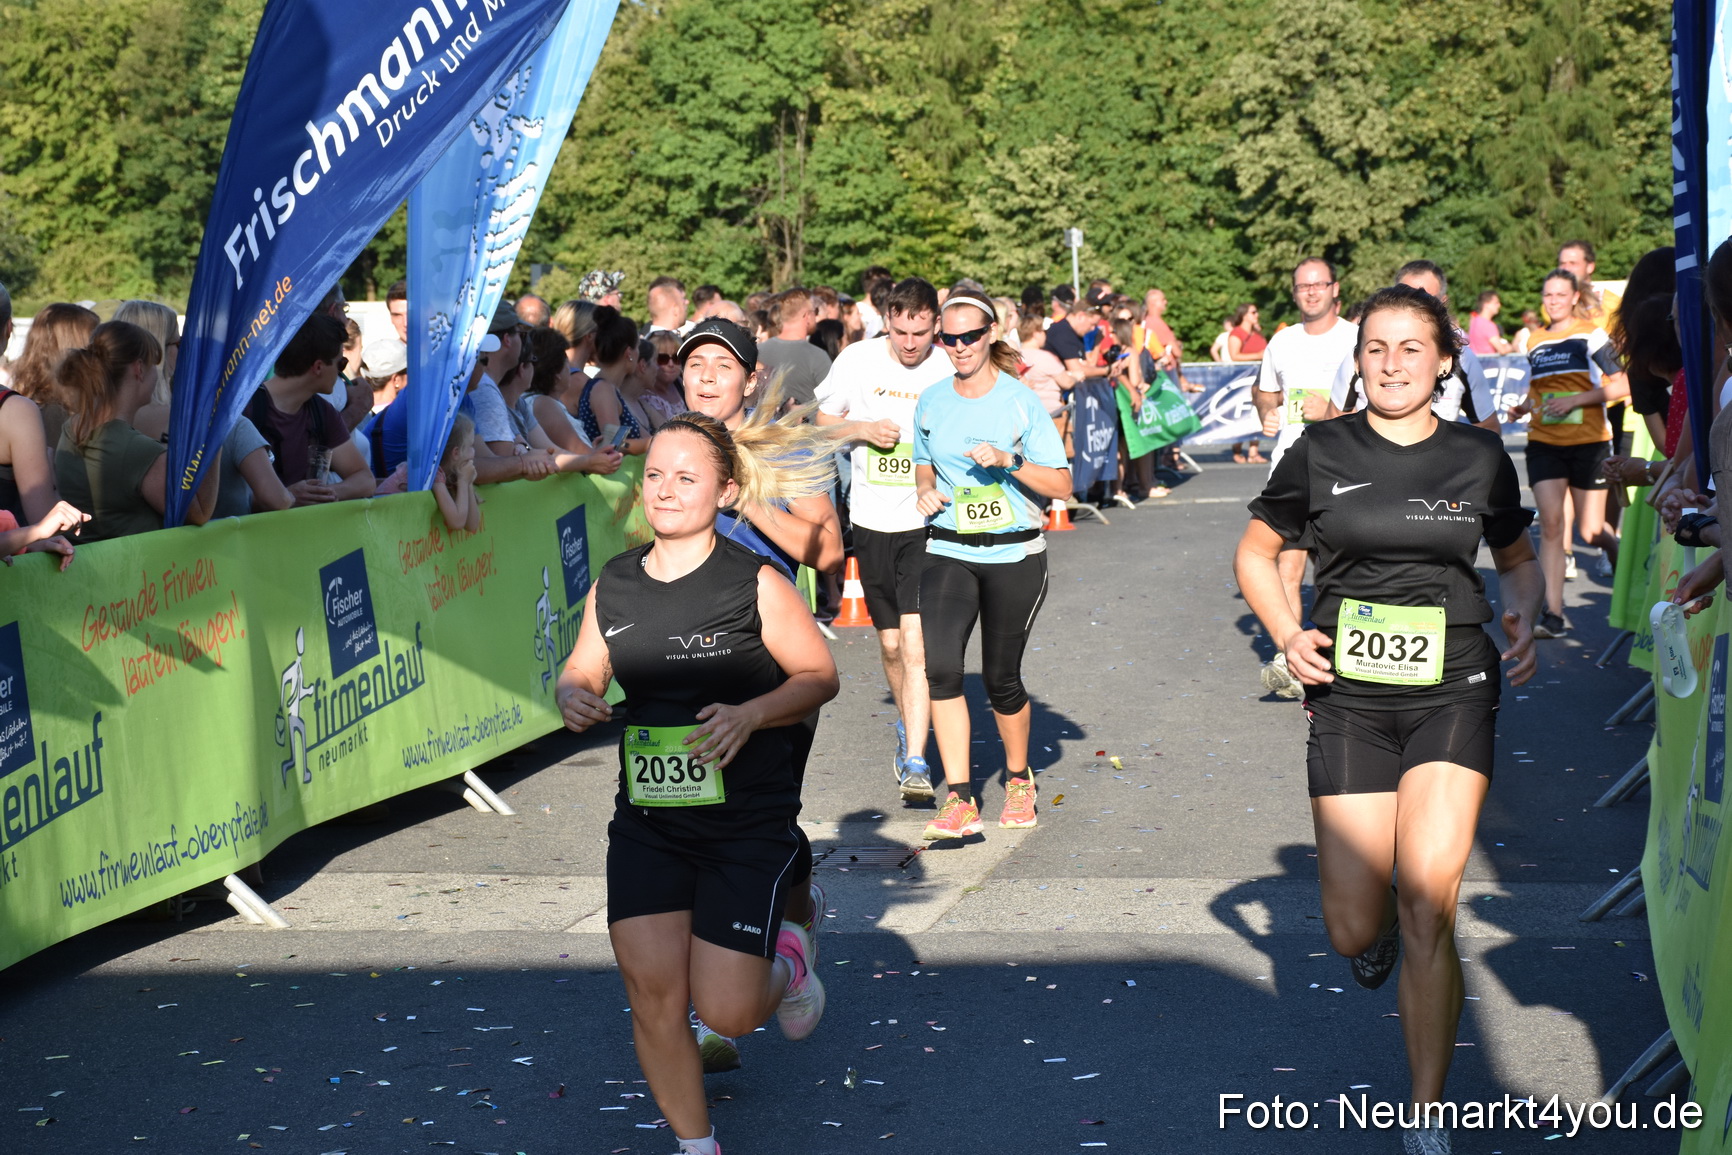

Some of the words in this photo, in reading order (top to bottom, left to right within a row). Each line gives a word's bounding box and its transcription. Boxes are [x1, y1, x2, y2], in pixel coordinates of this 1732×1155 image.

[376, 70, 441, 148] Druck
[440, 11, 482, 74] und
[878, 457, 911, 473] 899
[966, 501, 1002, 520] 626
[1437, 514, 1476, 523] UNLIMITED
[81, 570, 159, 653] Gesunde
[163, 556, 218, 611] Firmen
[332, 588, 363, 619] Fischer
[121, 632, 178, 698] laufen
[177, 590, 245, 668] länger!
[691, 648, 731, 659] UNLIMITED
[1347, 629, 1429, 663] 2032
[1355, 659, 1396, 670] Muratovic
[1398, 663, 1419, 671] Elisa
[1372, 669, 1399, 677] Unlimited
[313, 621, 425, 745] firmenlauf
[319, 722, 369, 771] neumarkt
[634, 755, 707, 784] 2036
[643, 785, 665, 793] Friedel
[666, 784, 702, 793] Christina
[743, 924, 762, 935] JAKO
